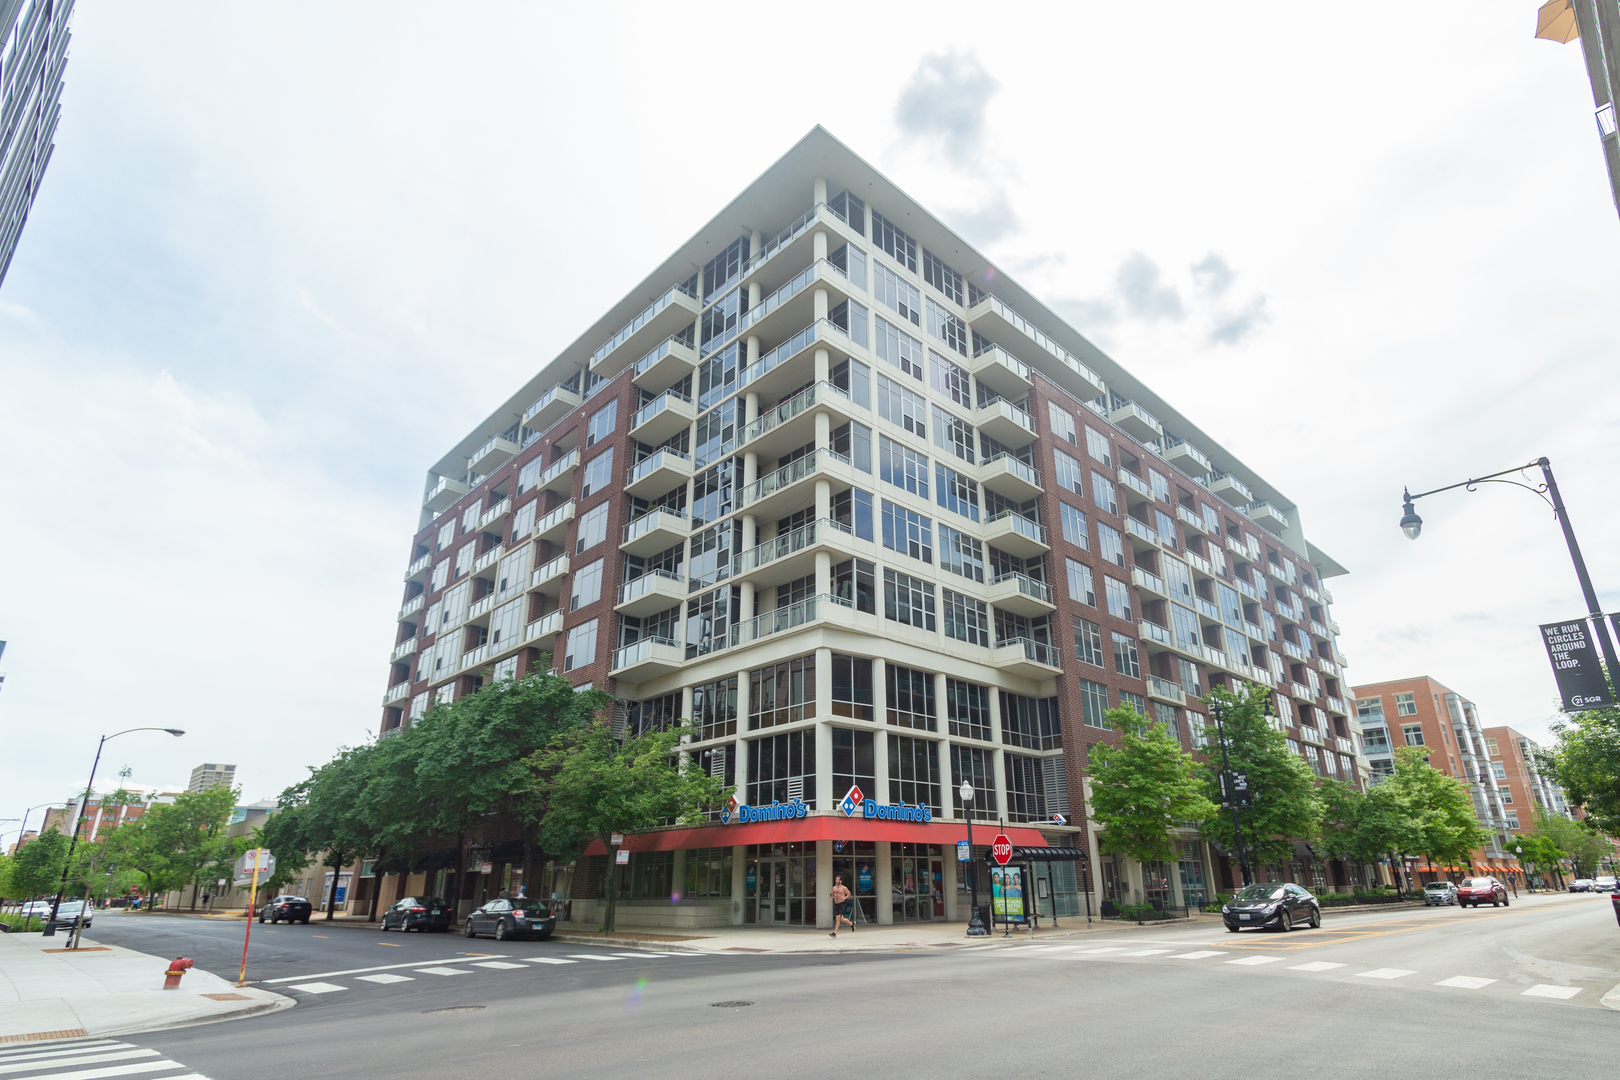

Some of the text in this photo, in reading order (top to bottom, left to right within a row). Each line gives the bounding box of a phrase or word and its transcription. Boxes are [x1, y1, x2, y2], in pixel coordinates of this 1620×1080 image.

[1544, 623, 1580, 636] WE RUN
[1548, 632, 1584, 644] CIRCLES
[1551, 640, 1586, 653] AROUND
[1552, 651, 1571, 661] THE
[1555, 659, 1581, 670] LOOP.
[739, 797, 808, 824] Domino's
[863, 799, 932, 822] Domino's
[994, 844, 1010, 856] STOP
